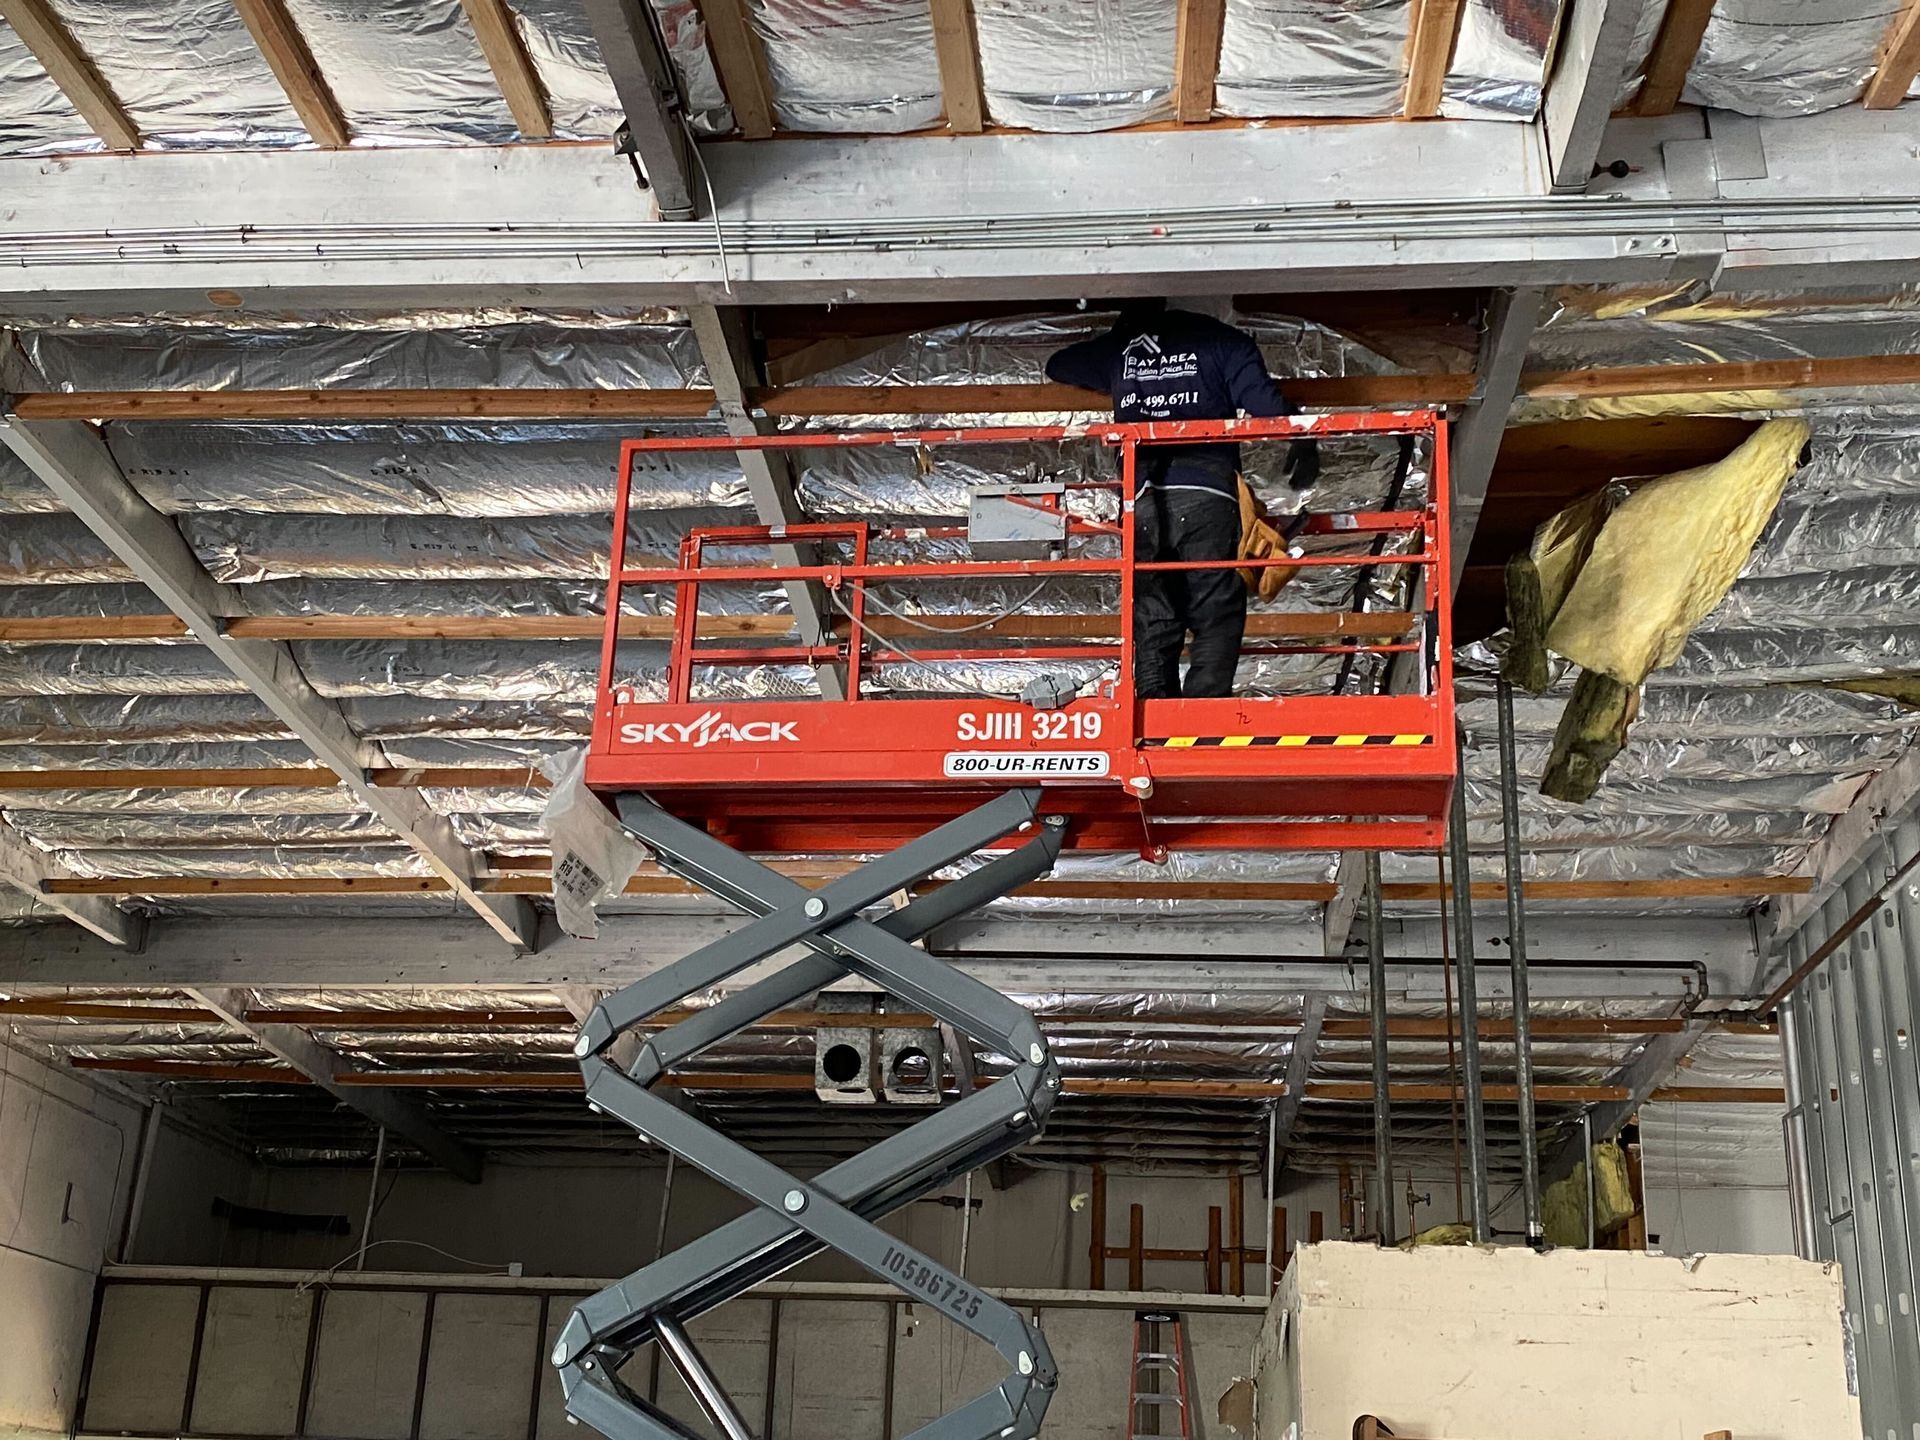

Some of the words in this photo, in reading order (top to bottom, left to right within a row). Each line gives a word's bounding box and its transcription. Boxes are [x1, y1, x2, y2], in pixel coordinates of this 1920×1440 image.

[1128, 356, 1156, 367] BAY
[1160, 353, 1197, 363] AREA
[620, 710, 800, 747] SKYJACK
[1031, 711, 1102, 740] 3219
[952, 757, 1100, 771] 800-UR-RENTS
[881, 1247, 983, 1319] 10586725
